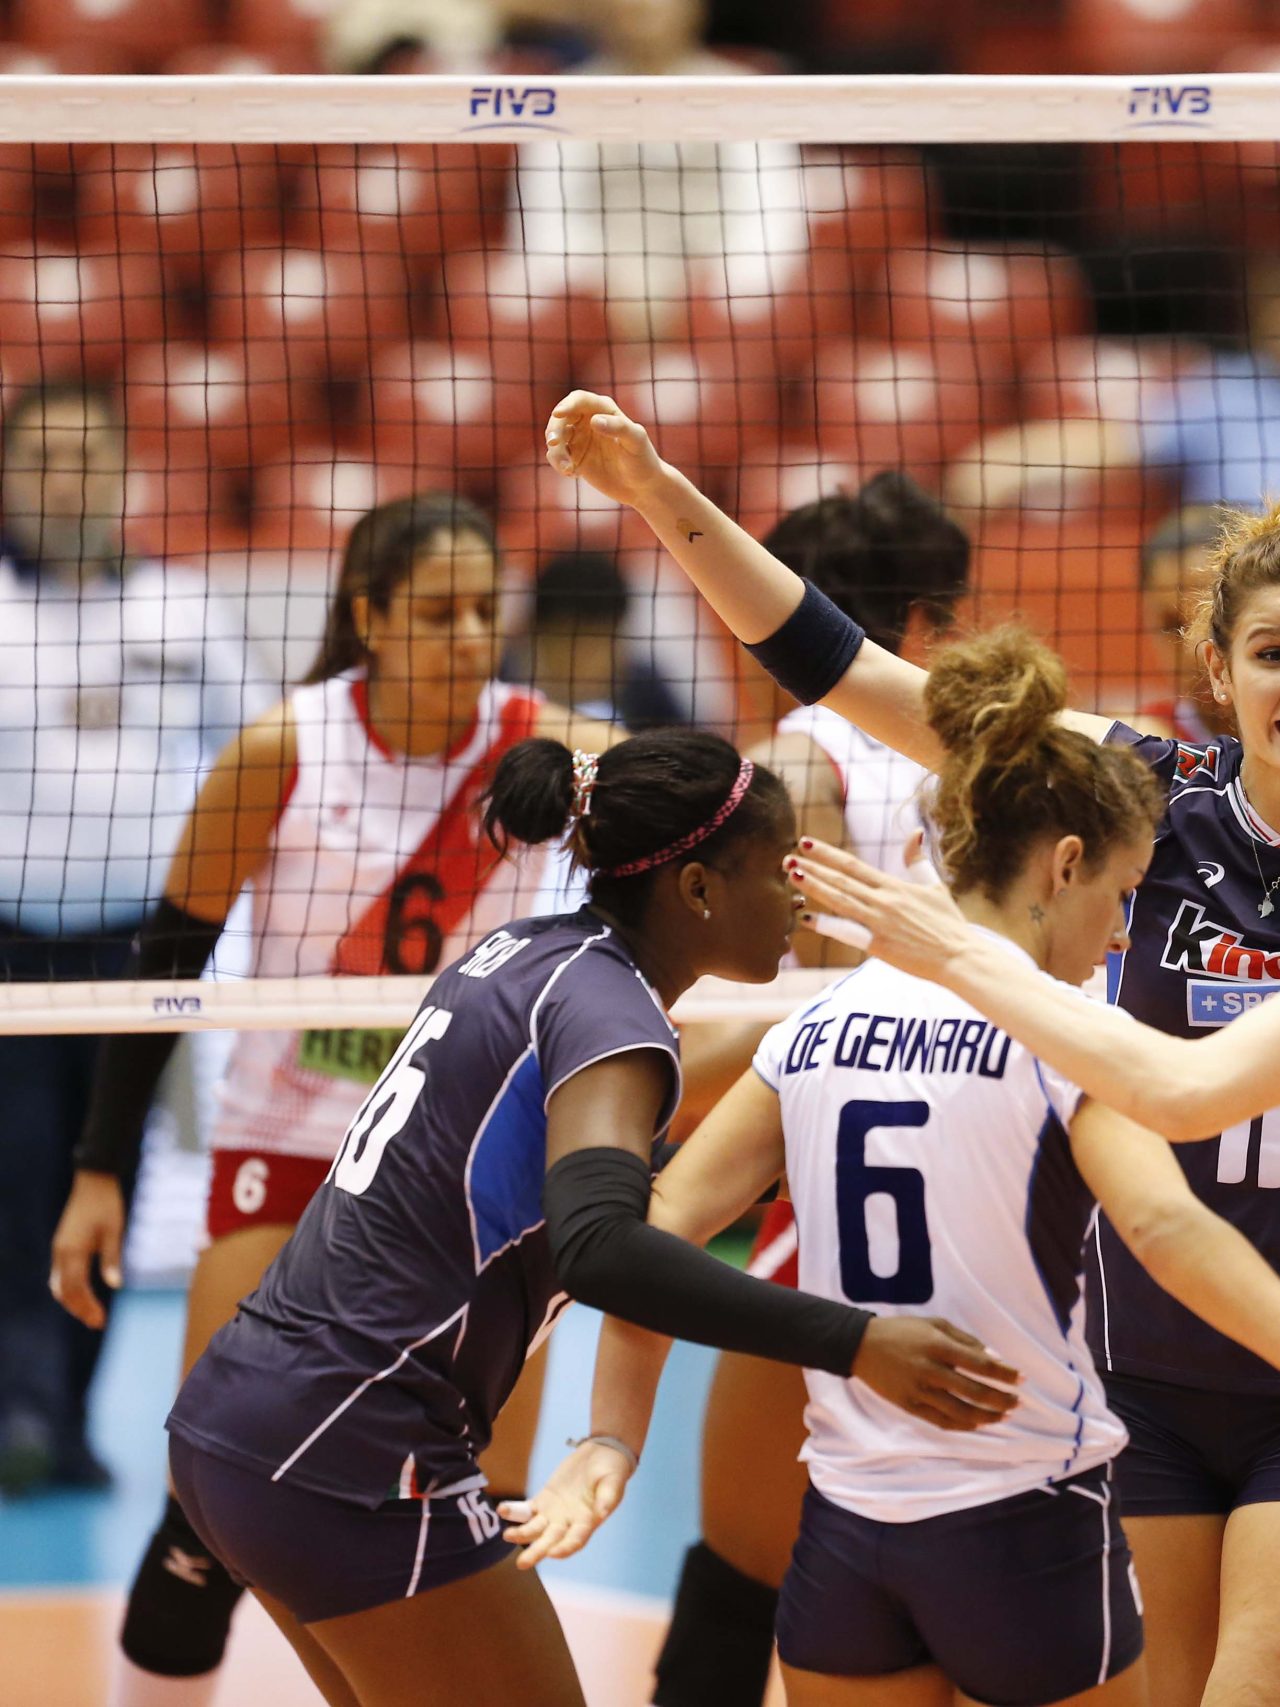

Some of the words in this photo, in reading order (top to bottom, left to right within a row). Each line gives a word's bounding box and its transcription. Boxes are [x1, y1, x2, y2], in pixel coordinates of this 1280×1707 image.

[469, 87, 556, 117] FIVB
[1129, 86, 1211, 114] FIVB
[384, 873, 445, 976] 6
[153, 997, 200, 1012] FIVB
[784, 1016, 838, 1075] DE
[833, 1012, 1014, 1080] GENNARO
[325, 1005, 453, 1196] 16
[232, 1157, 270, 1214] 6
[836, 1099, 934, 1305] 6
[457, 1488, 501, 1547] 16
